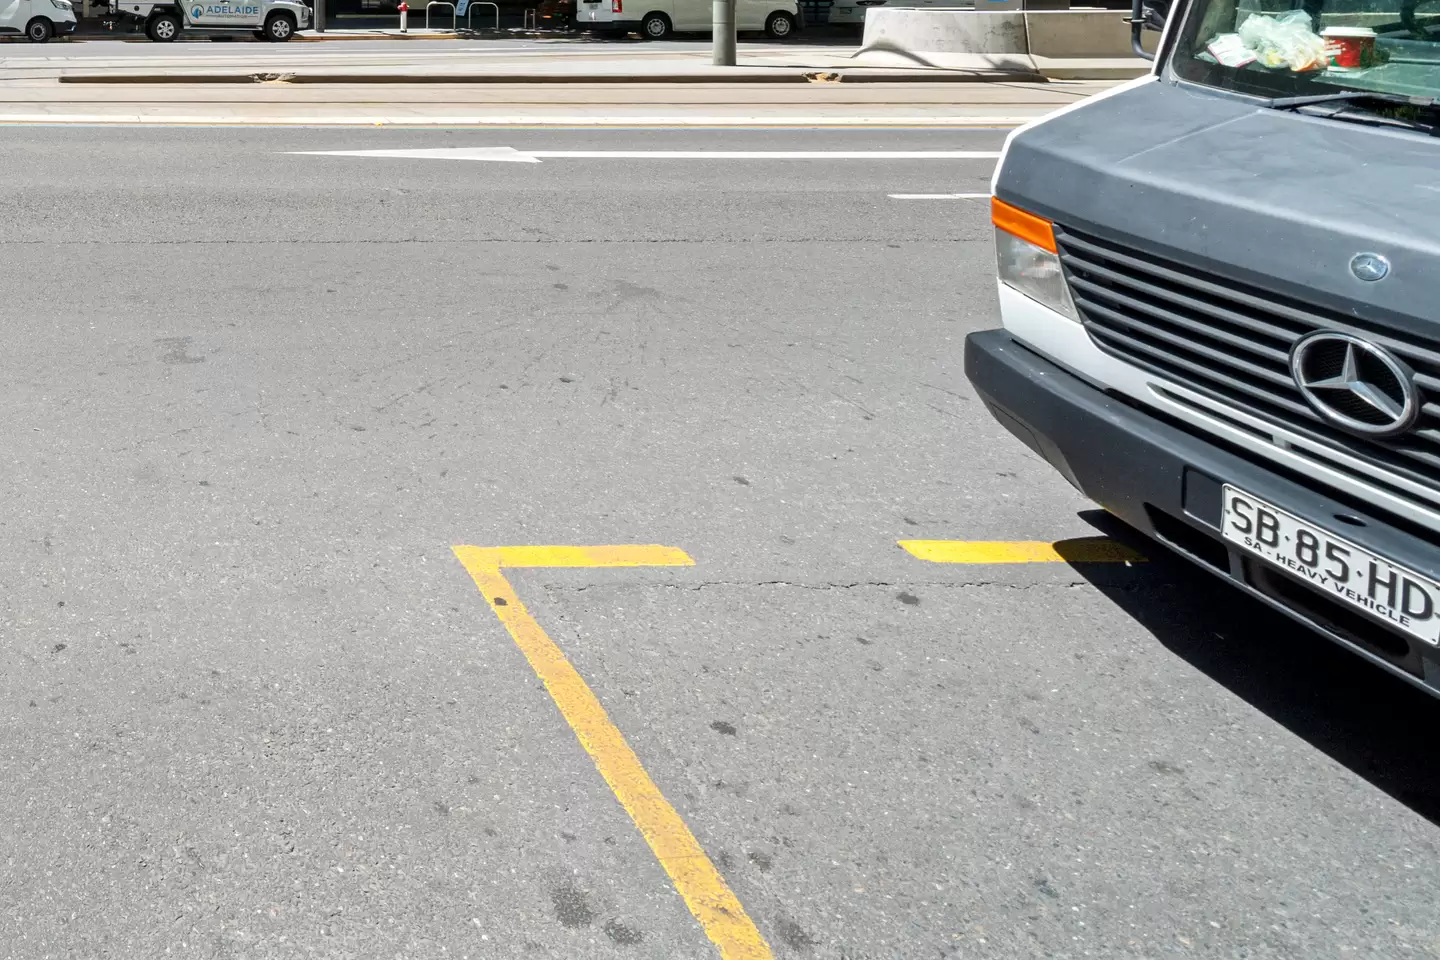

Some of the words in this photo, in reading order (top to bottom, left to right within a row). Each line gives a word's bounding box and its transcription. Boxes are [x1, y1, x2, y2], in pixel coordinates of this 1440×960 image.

[206, 5, 259, 15] ADELAIDE
[1244, 536, 1263, 553] SA
[1276, 552, 1329, 585] HEAVY
[1334, 581, 1410, 628] VEHICLE
